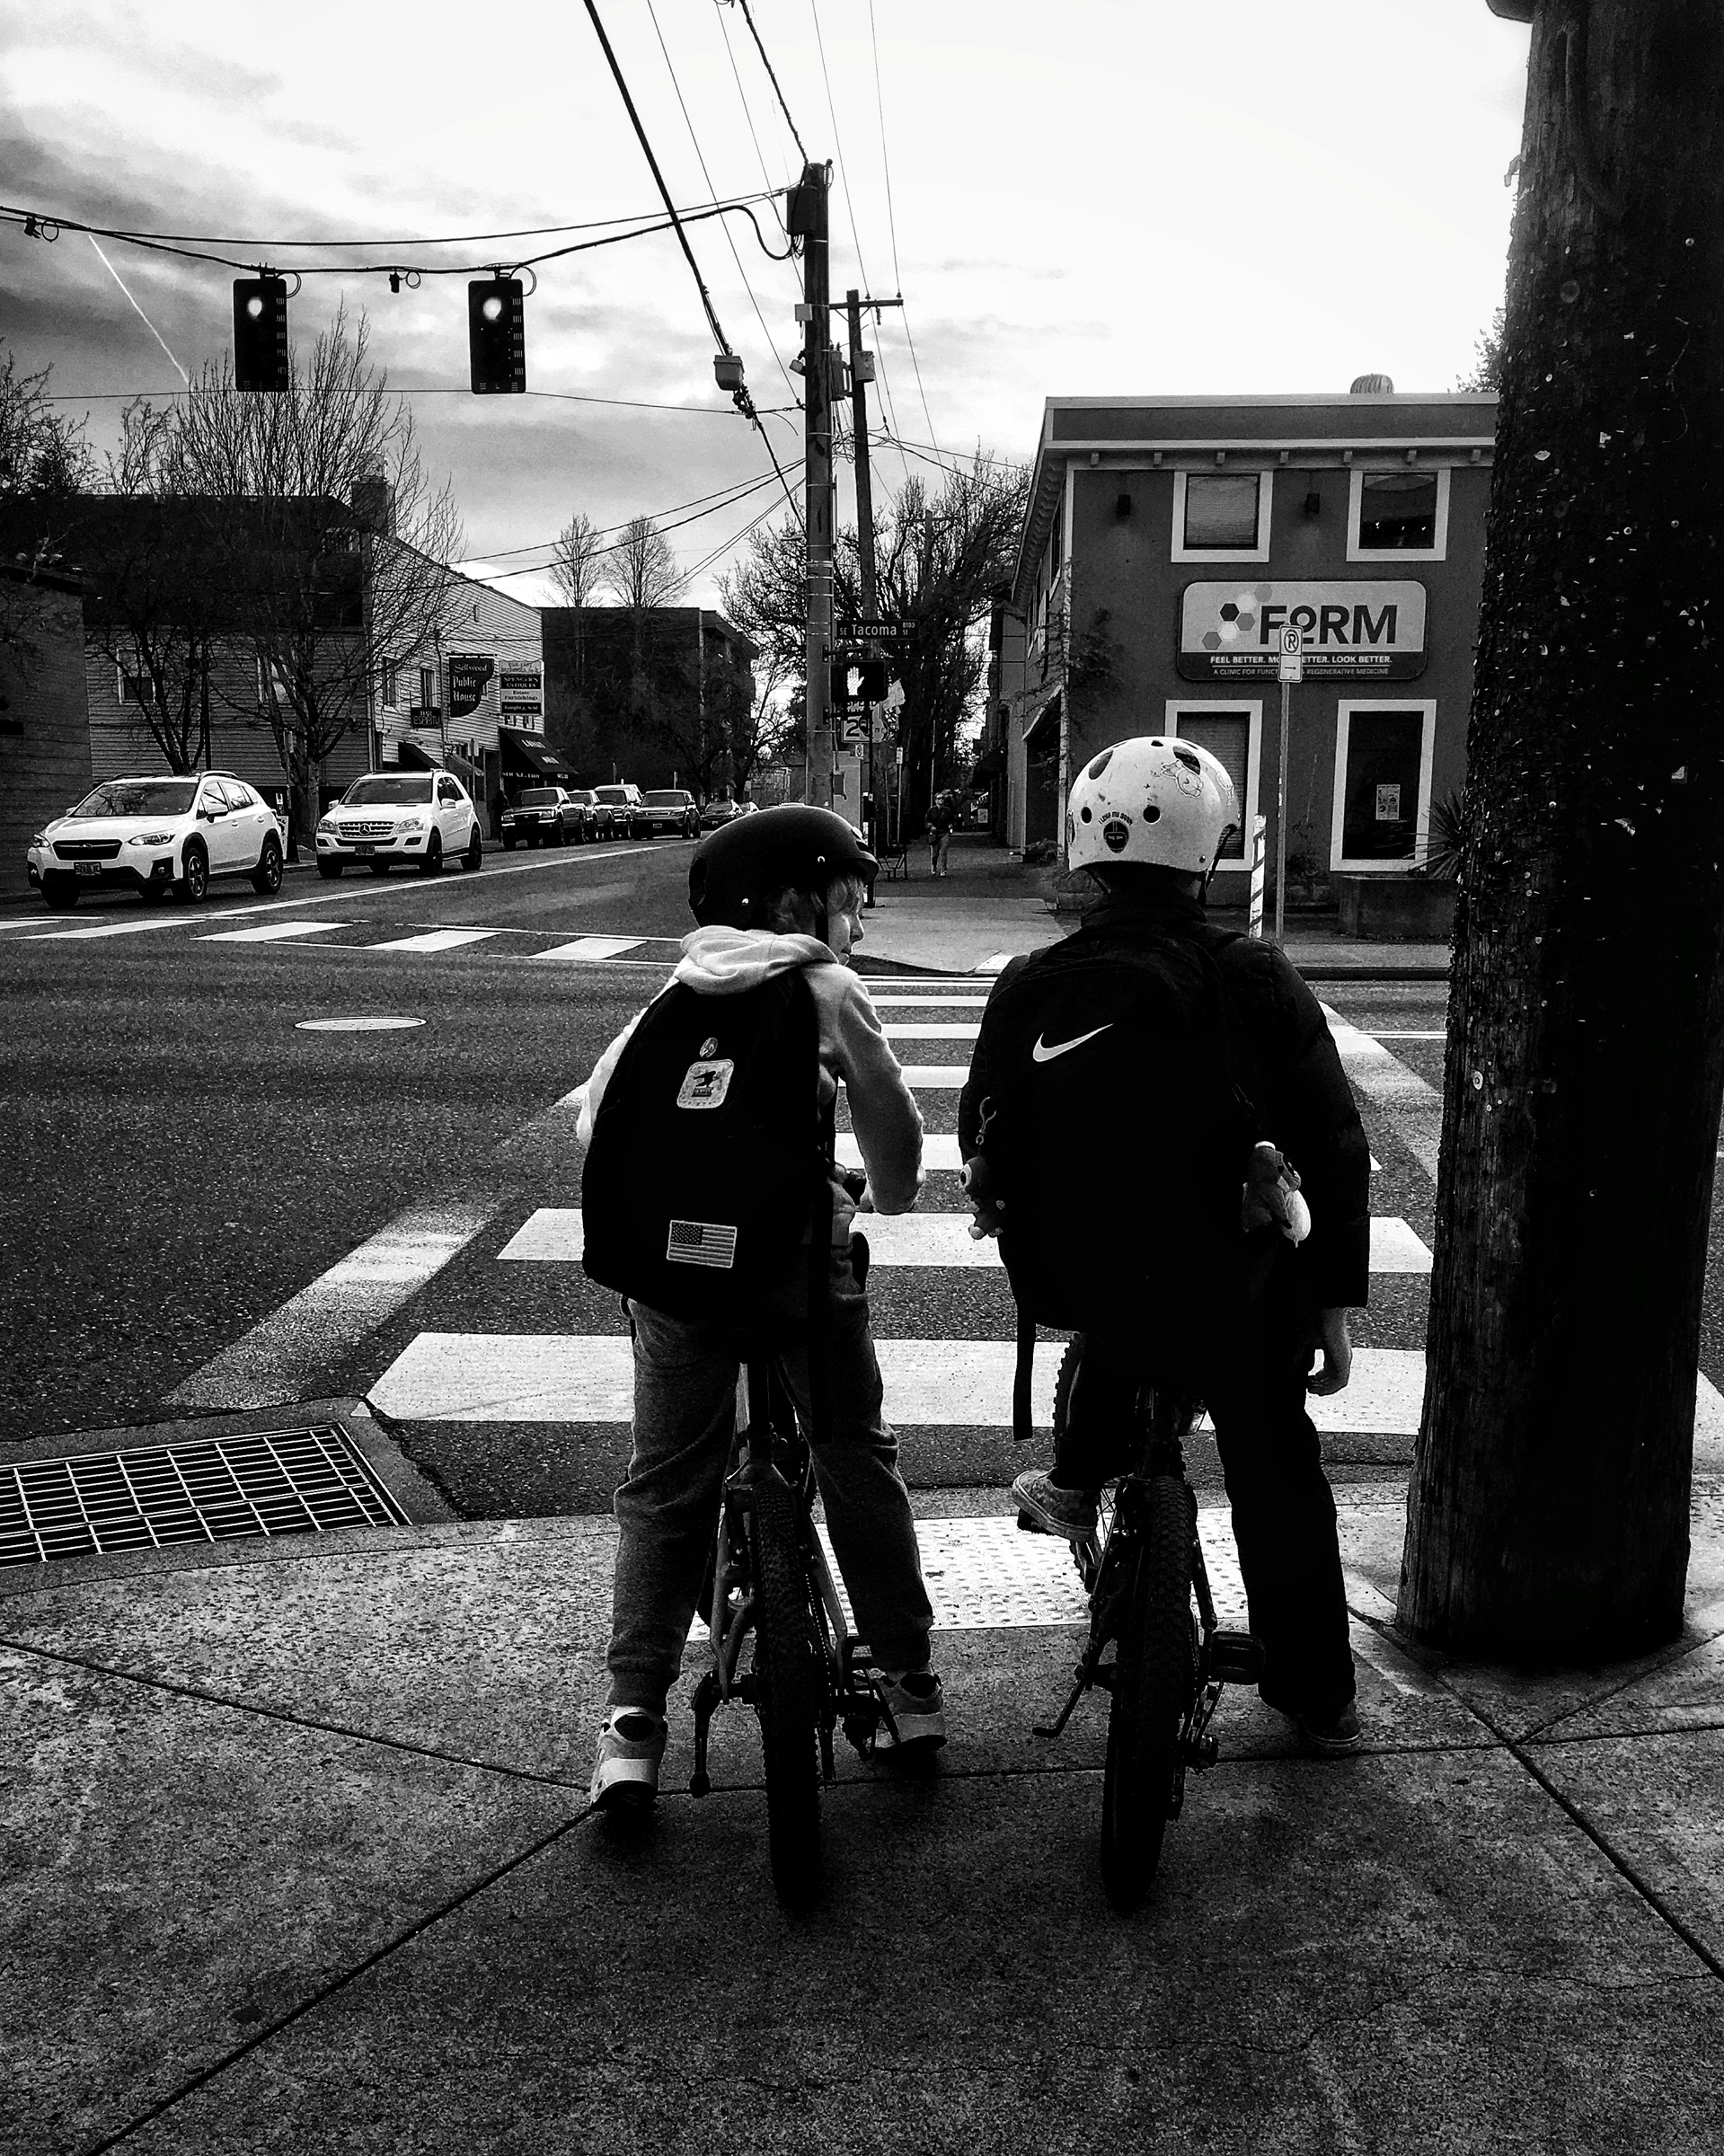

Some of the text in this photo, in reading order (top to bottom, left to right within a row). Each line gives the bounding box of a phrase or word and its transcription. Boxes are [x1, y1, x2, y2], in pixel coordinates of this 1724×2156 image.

[839, 627, 847, 636] SE
[852, 623, 897, 636] Tacoma
[1260, 605, 1399, 645] FORM
[1210, 656, 1230, 664] FEEL
[1233, 656, 1266, 664] BETTER.
[1301, 655, 1330, 663] ETTER.
[1331, 655, 1357, 663] LOOK
[1358, 655, 1392, 663] BETTER.
[454, 664, 488, 673] Sellwood
[453, 676, 477, 689] Public
[453, 690, 476, 702] House
